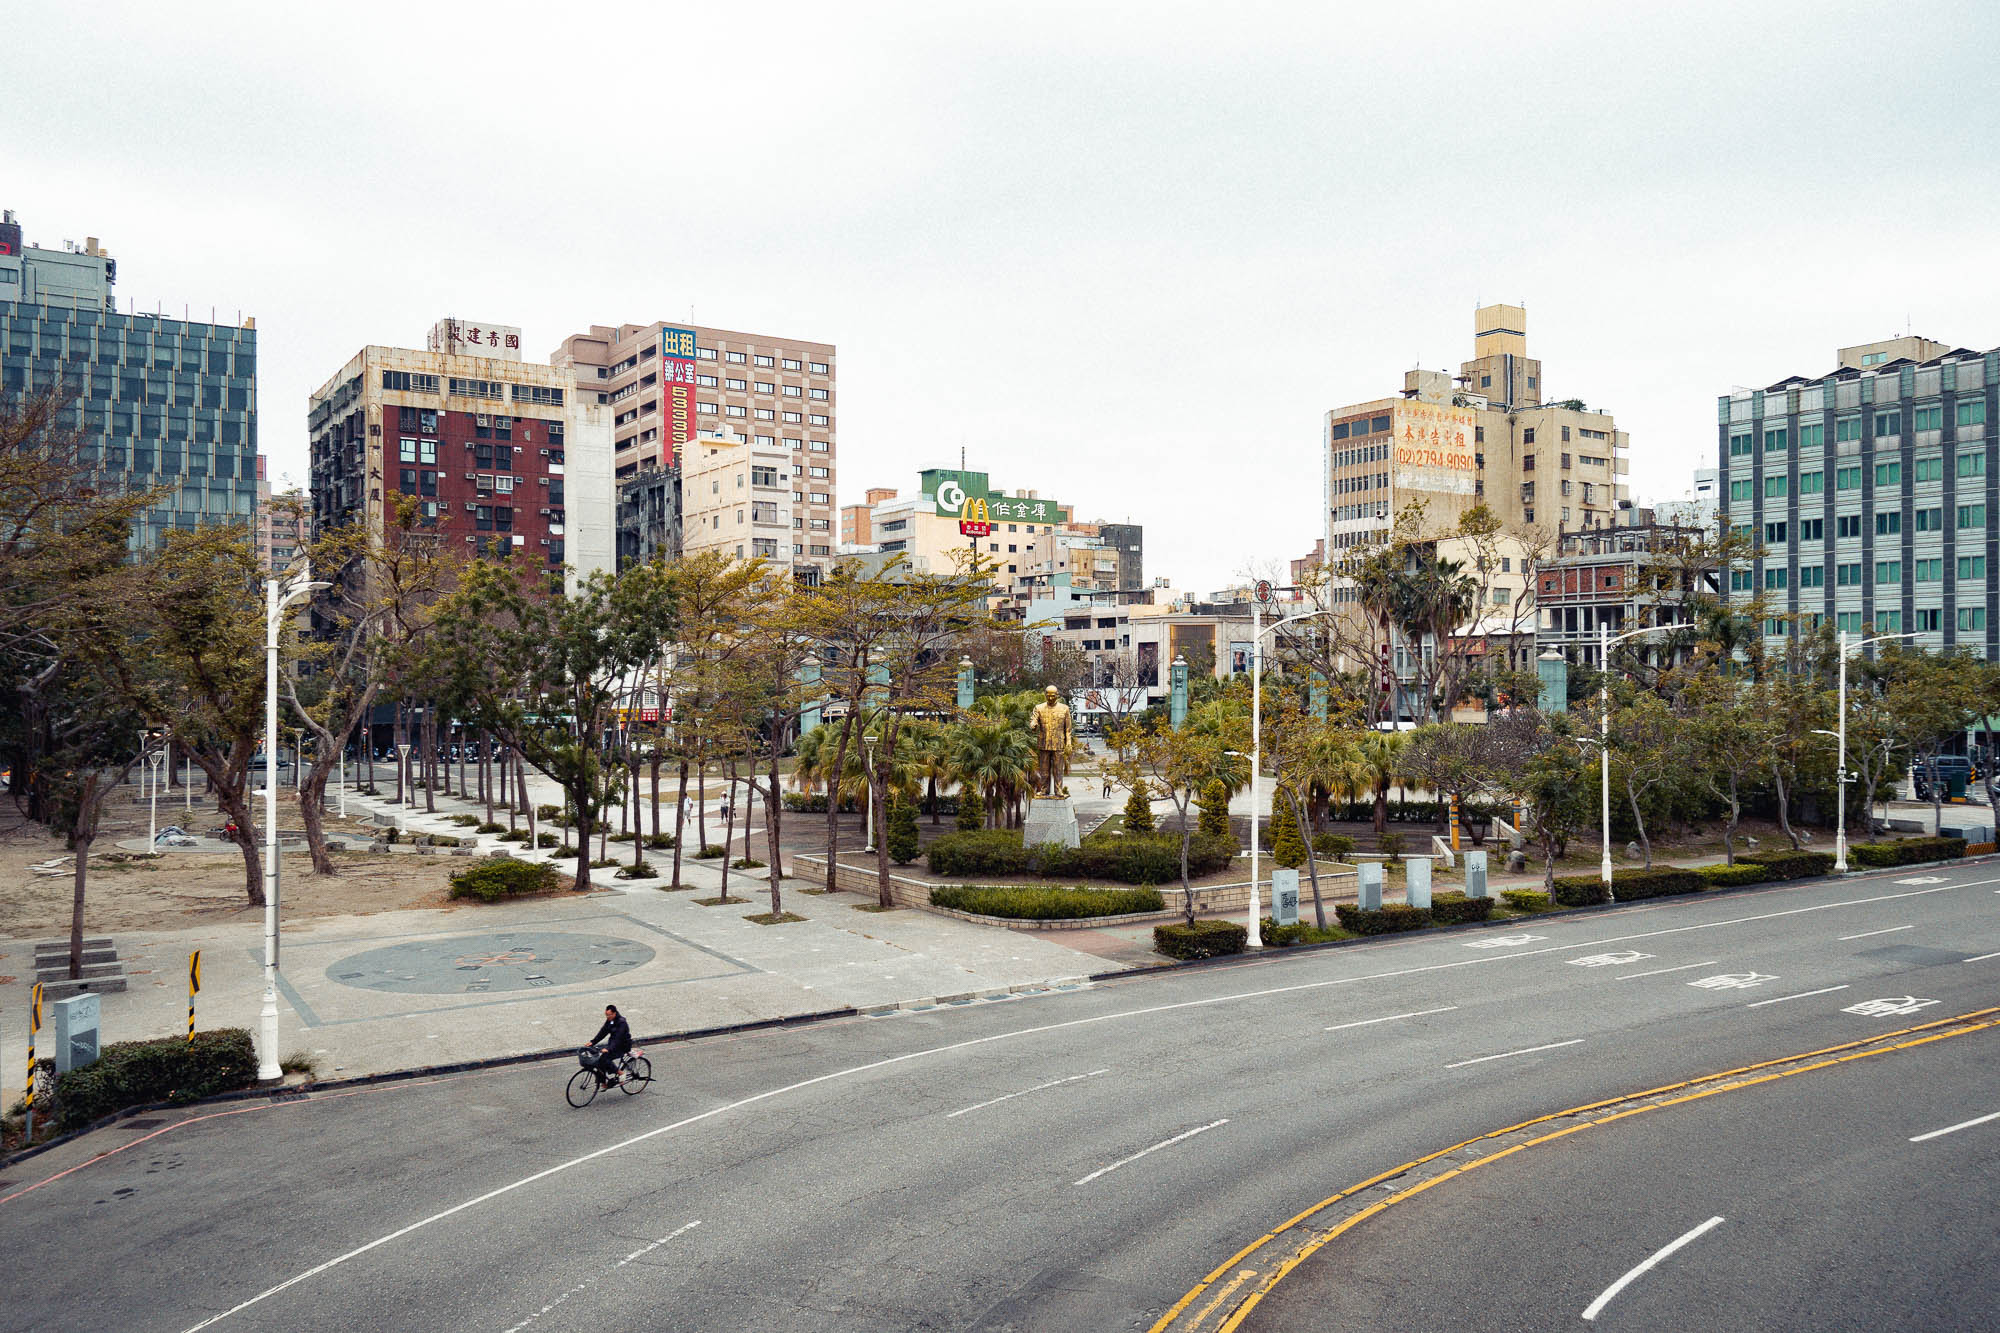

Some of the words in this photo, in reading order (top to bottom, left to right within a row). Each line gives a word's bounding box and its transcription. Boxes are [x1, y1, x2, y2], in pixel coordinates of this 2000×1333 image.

[665, 331, 694, 357] 出租
[664, 359, 695, 384] 辦公室
[672, 385, 688, 463] 533332
